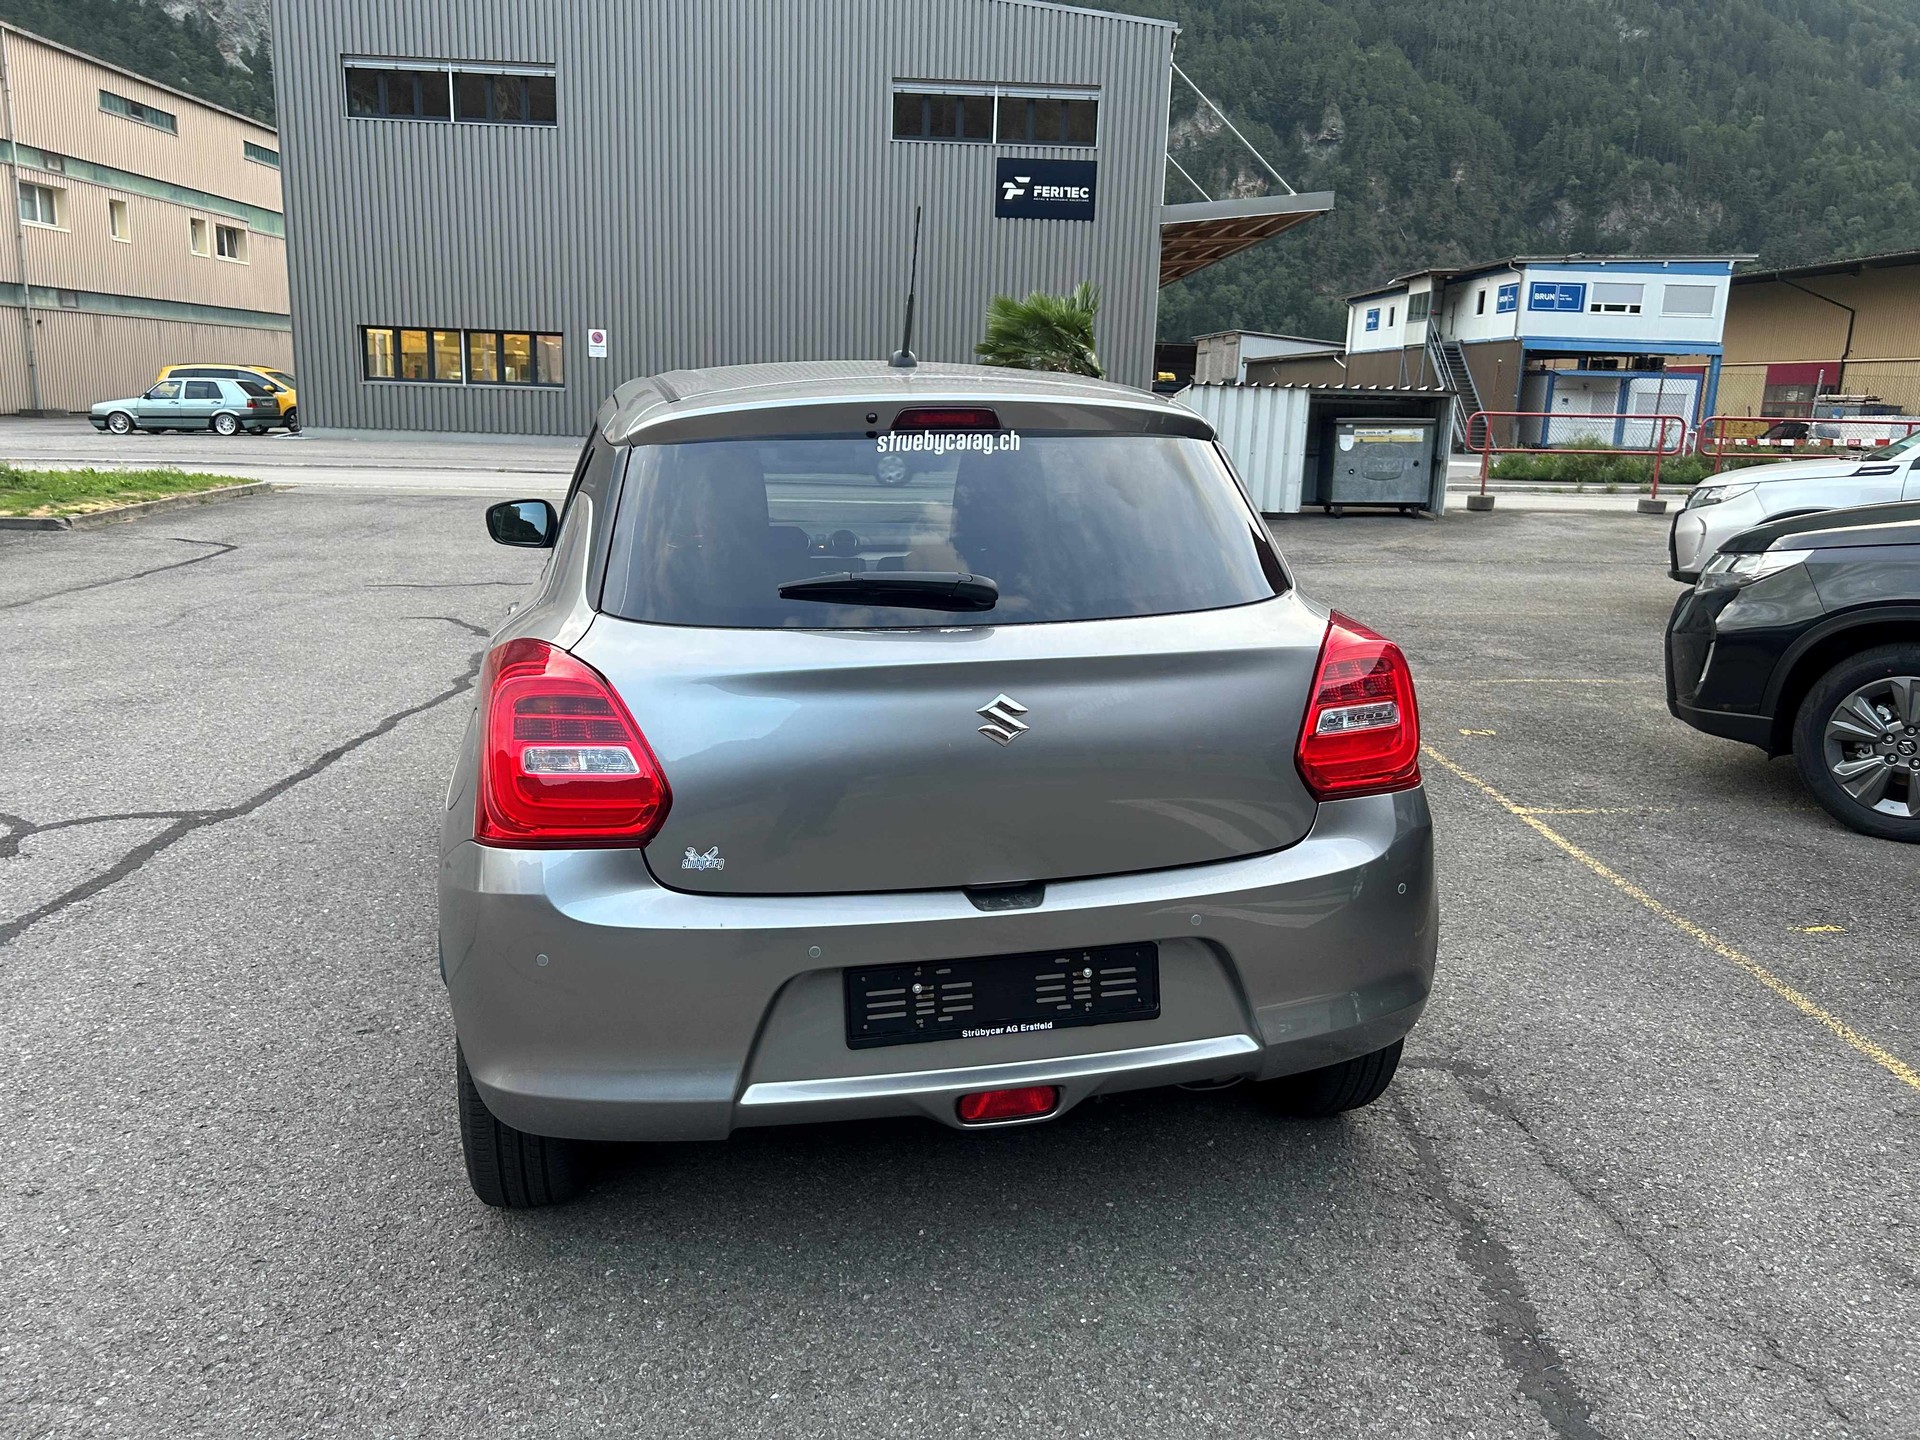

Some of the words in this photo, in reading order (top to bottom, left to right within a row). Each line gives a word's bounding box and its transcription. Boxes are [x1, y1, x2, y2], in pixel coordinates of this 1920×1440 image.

[1033, 185, 1090, 199] FERITEC
[1534, 292, 1555, 301] BRUN
[876, 429, 1021, 455] struebycarag.ch
[961, 1026, 1004, 1038] Strübycar
[1006, 1024, 1018, 1034] AG
[1020, 1021, 1053, 1032] Erstfeld
